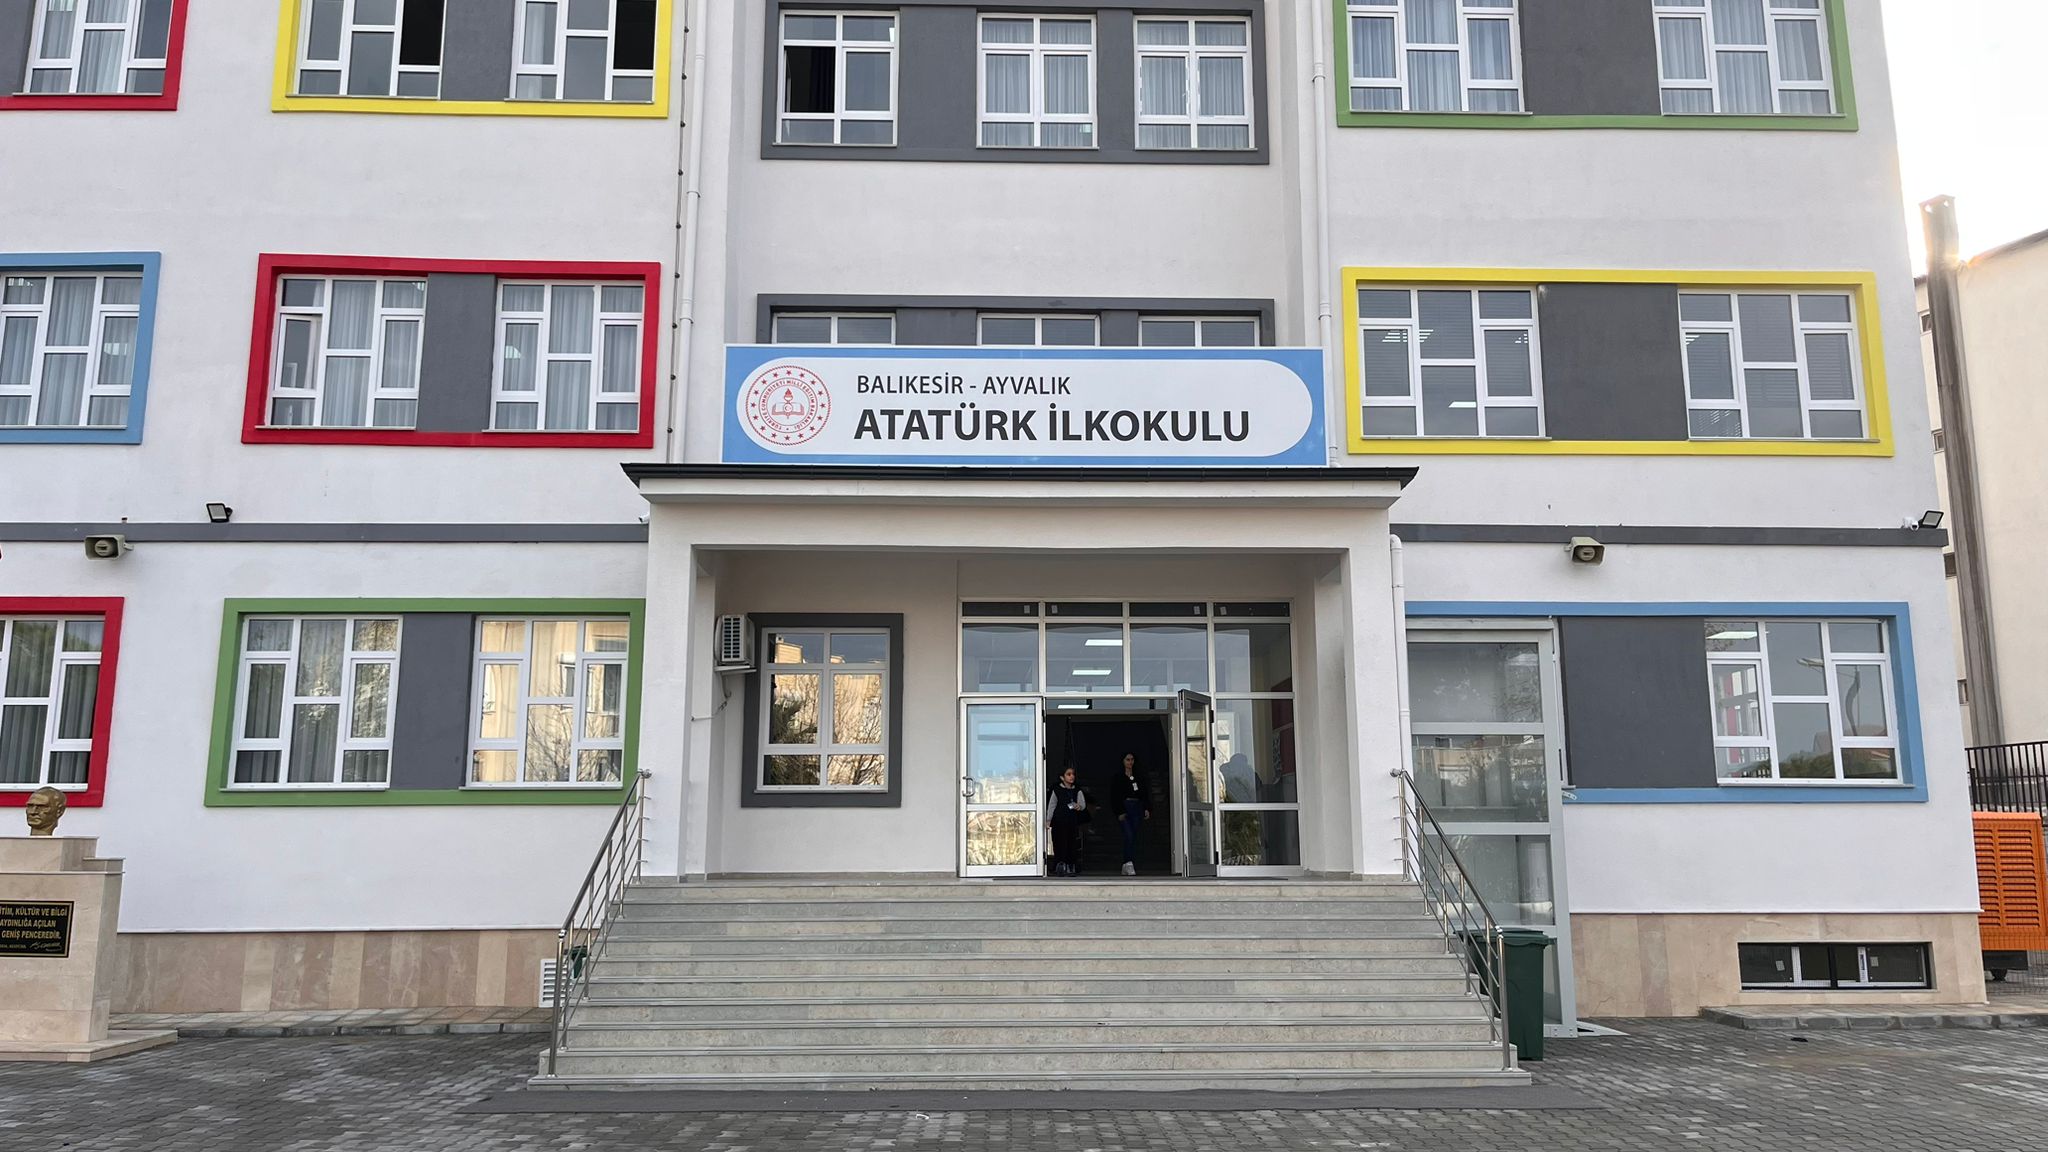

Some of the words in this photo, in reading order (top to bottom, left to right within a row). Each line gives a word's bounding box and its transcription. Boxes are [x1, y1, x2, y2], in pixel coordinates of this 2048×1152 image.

[857, 372, 963, 394] BALIKESİR
[983, 376, 1071, 395] AYVALIK
[854, 402, 1037, 440] ATATÜRK
[1049, 402, 1249, 442] İLKOKULU
[15, 906, 40, 916] KÜLTÜR
[41, 908, 50, 916] VE
[51, 906, 67, 916] BİLGİ
[33, 920, 56, 929] AÇILAN
[1, 930, 20, 940] GENİŞ
